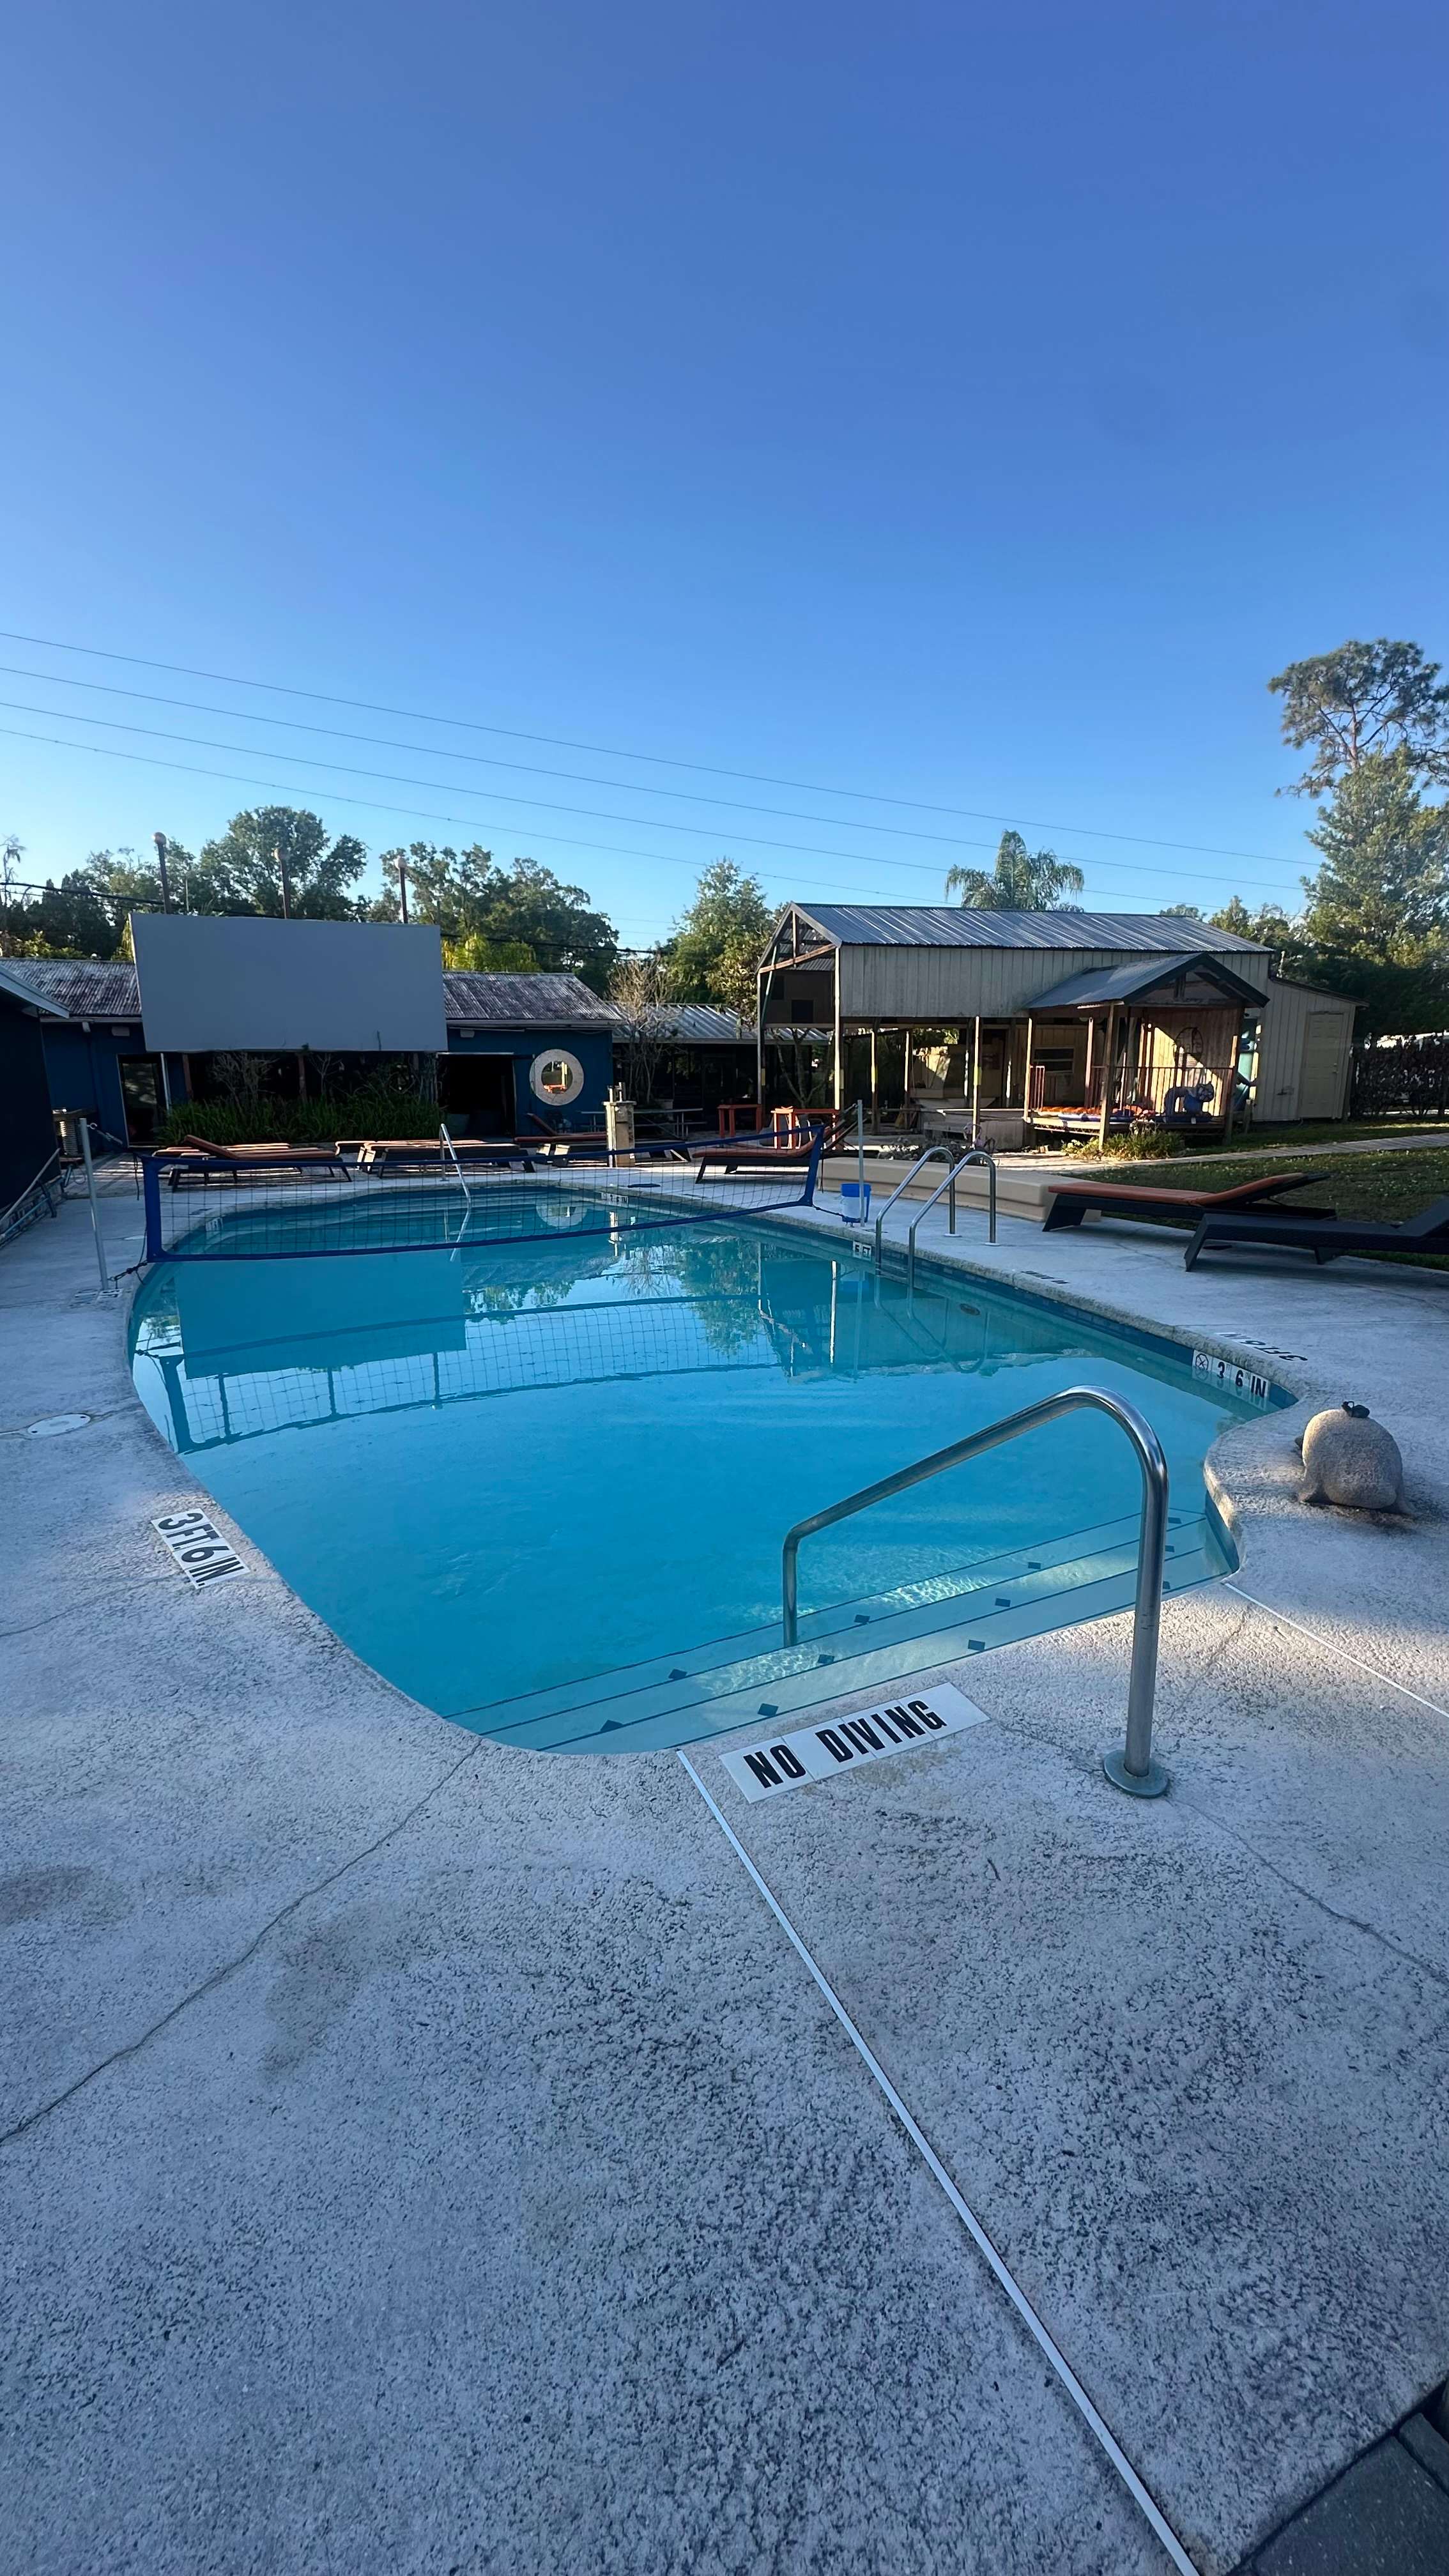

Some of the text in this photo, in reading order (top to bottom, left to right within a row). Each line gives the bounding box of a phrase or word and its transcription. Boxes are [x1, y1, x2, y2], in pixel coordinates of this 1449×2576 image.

[1217, 1361, 1225, 1379] 3
[1236, 1370, 1243, 1387] 6
[1251, 1376, 1267, 1398] IN
[158, 1513, 203, 1530] 3
[181, 1545, 229, 1563] 6
[189, 1556, 245, 1586] IN.
[743, 1700, 947, 1789] NO DIVING
